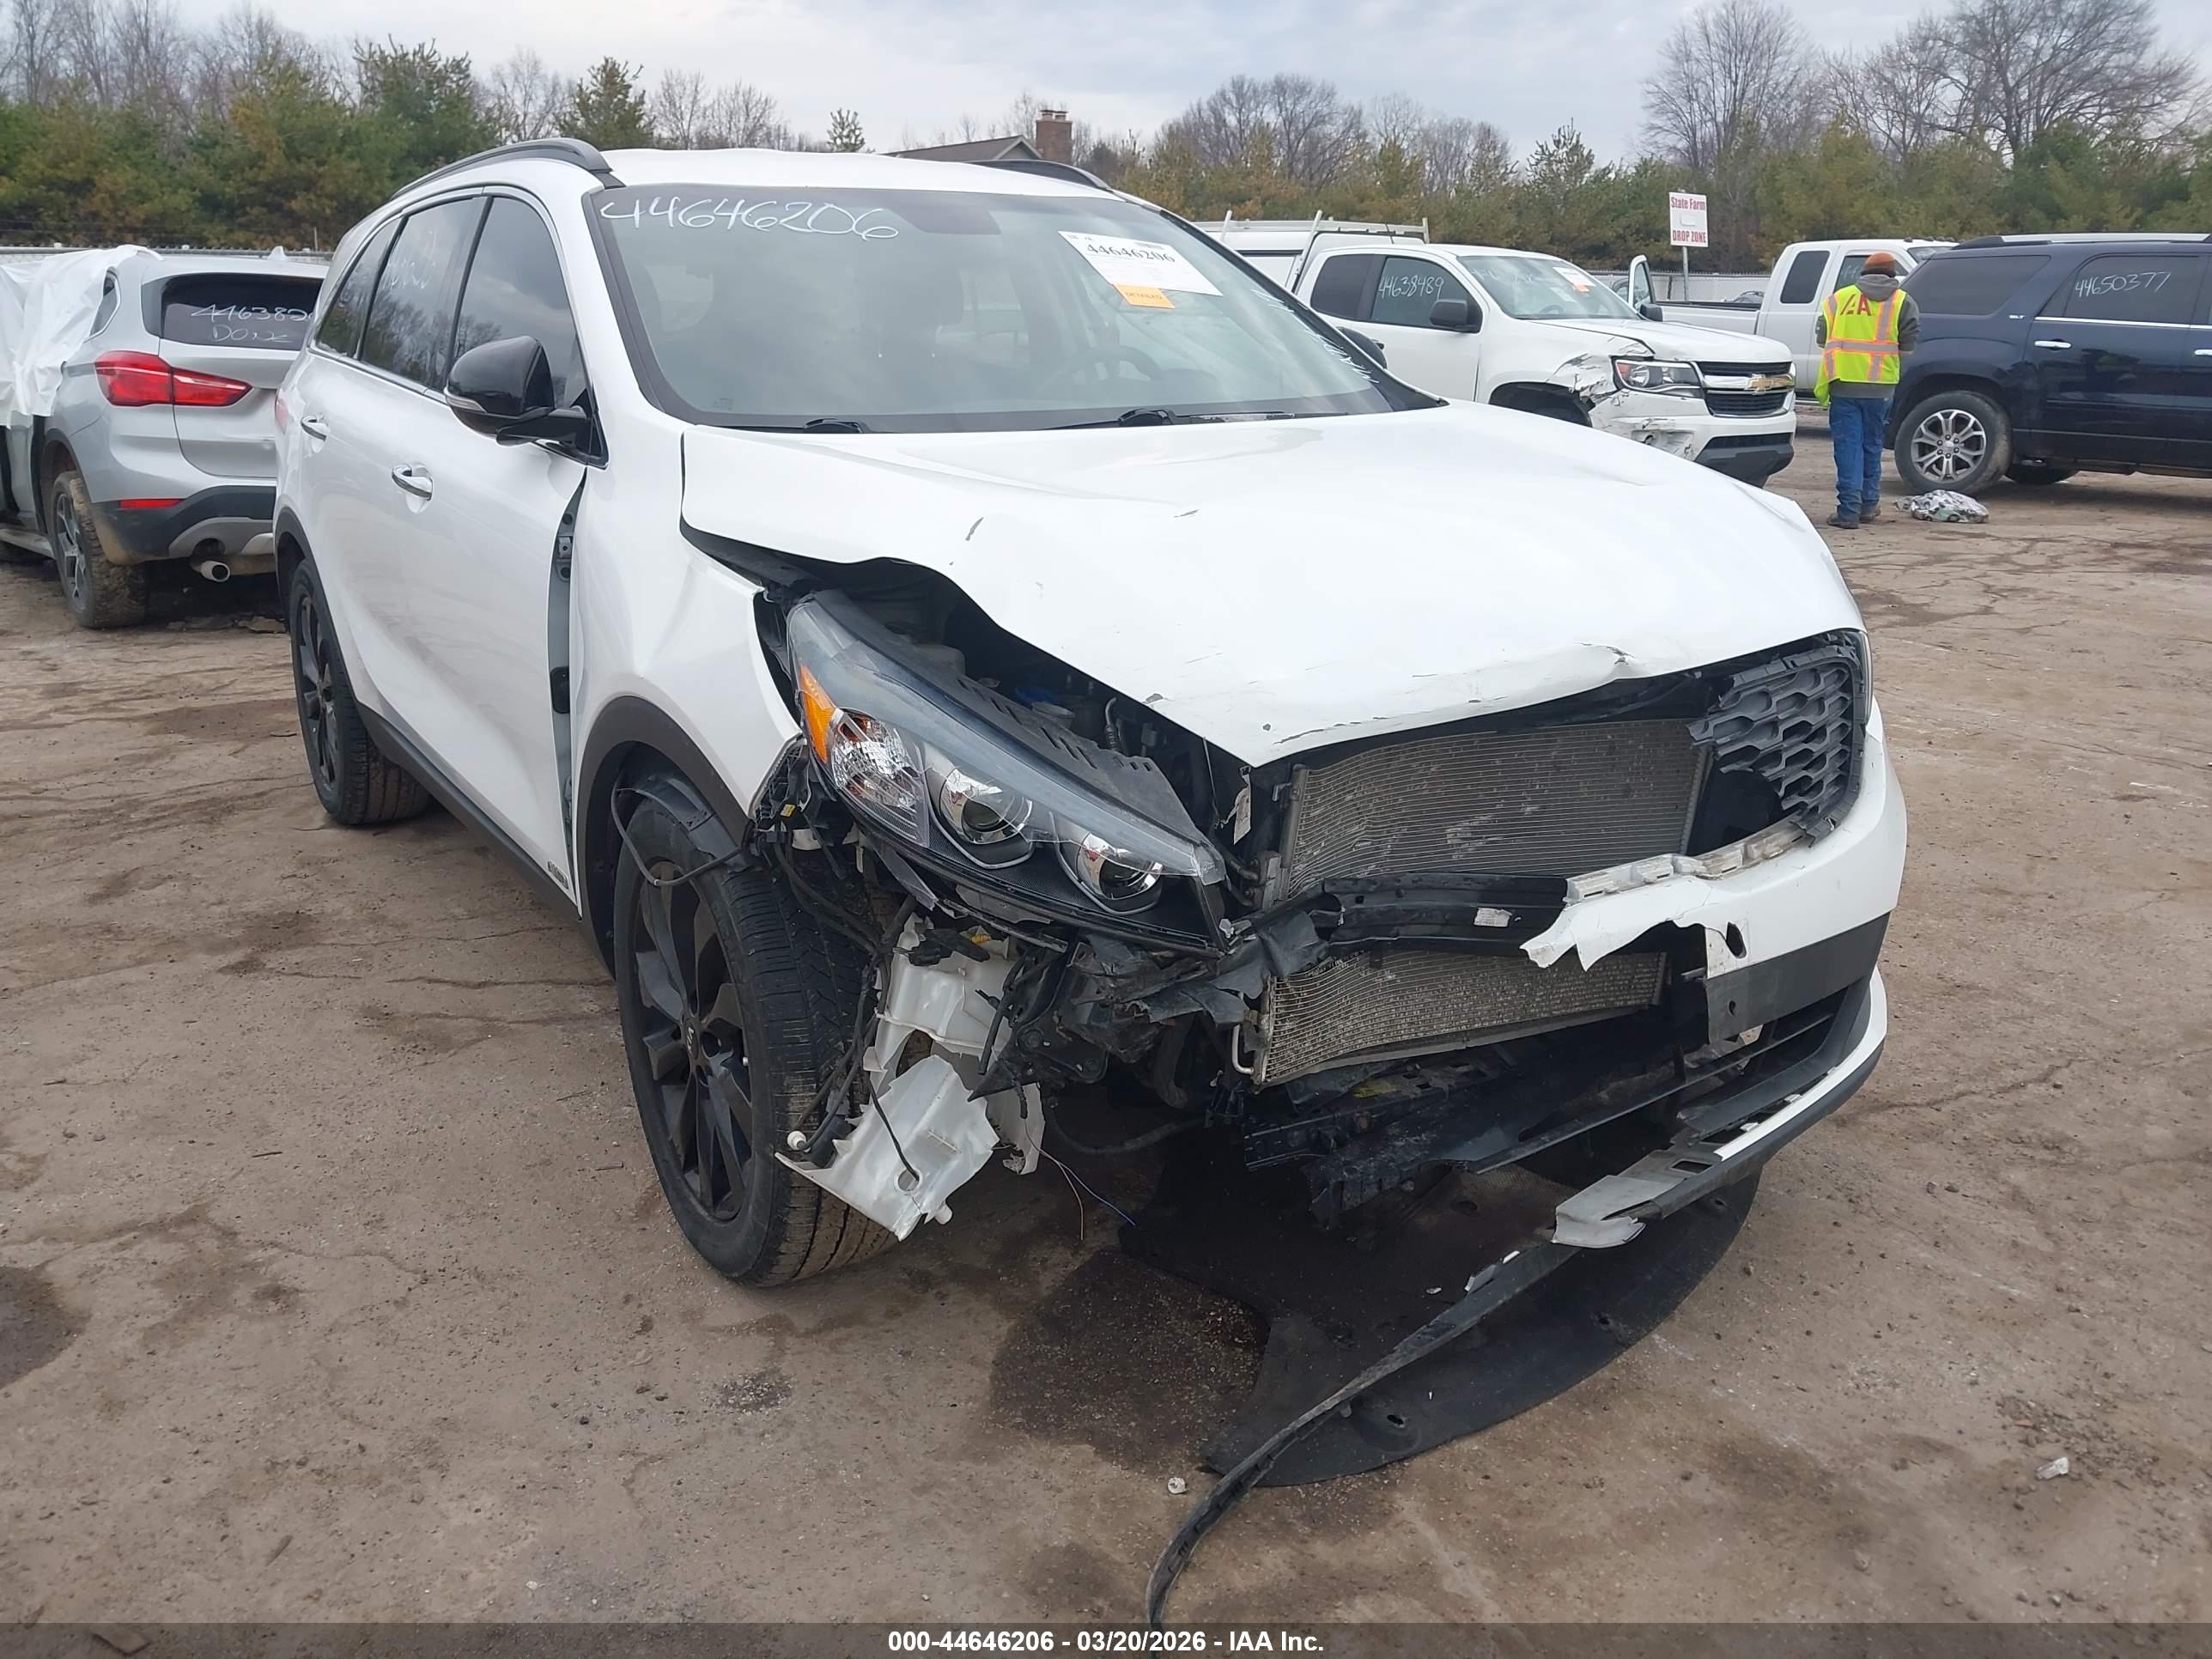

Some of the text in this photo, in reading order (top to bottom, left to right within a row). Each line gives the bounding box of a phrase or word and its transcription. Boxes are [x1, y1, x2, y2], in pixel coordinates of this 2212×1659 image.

[1671, 197, 1705, 210] State Farm
[600, 196, 899, 241] 44646206
[1673, 230, 1706, 243] DROP ZONE
[1087, 243, 1176, 263] 44646206
[1378, 275, 1444, 301] 44638489
[2075, 271, 2172, 298] 44650377
